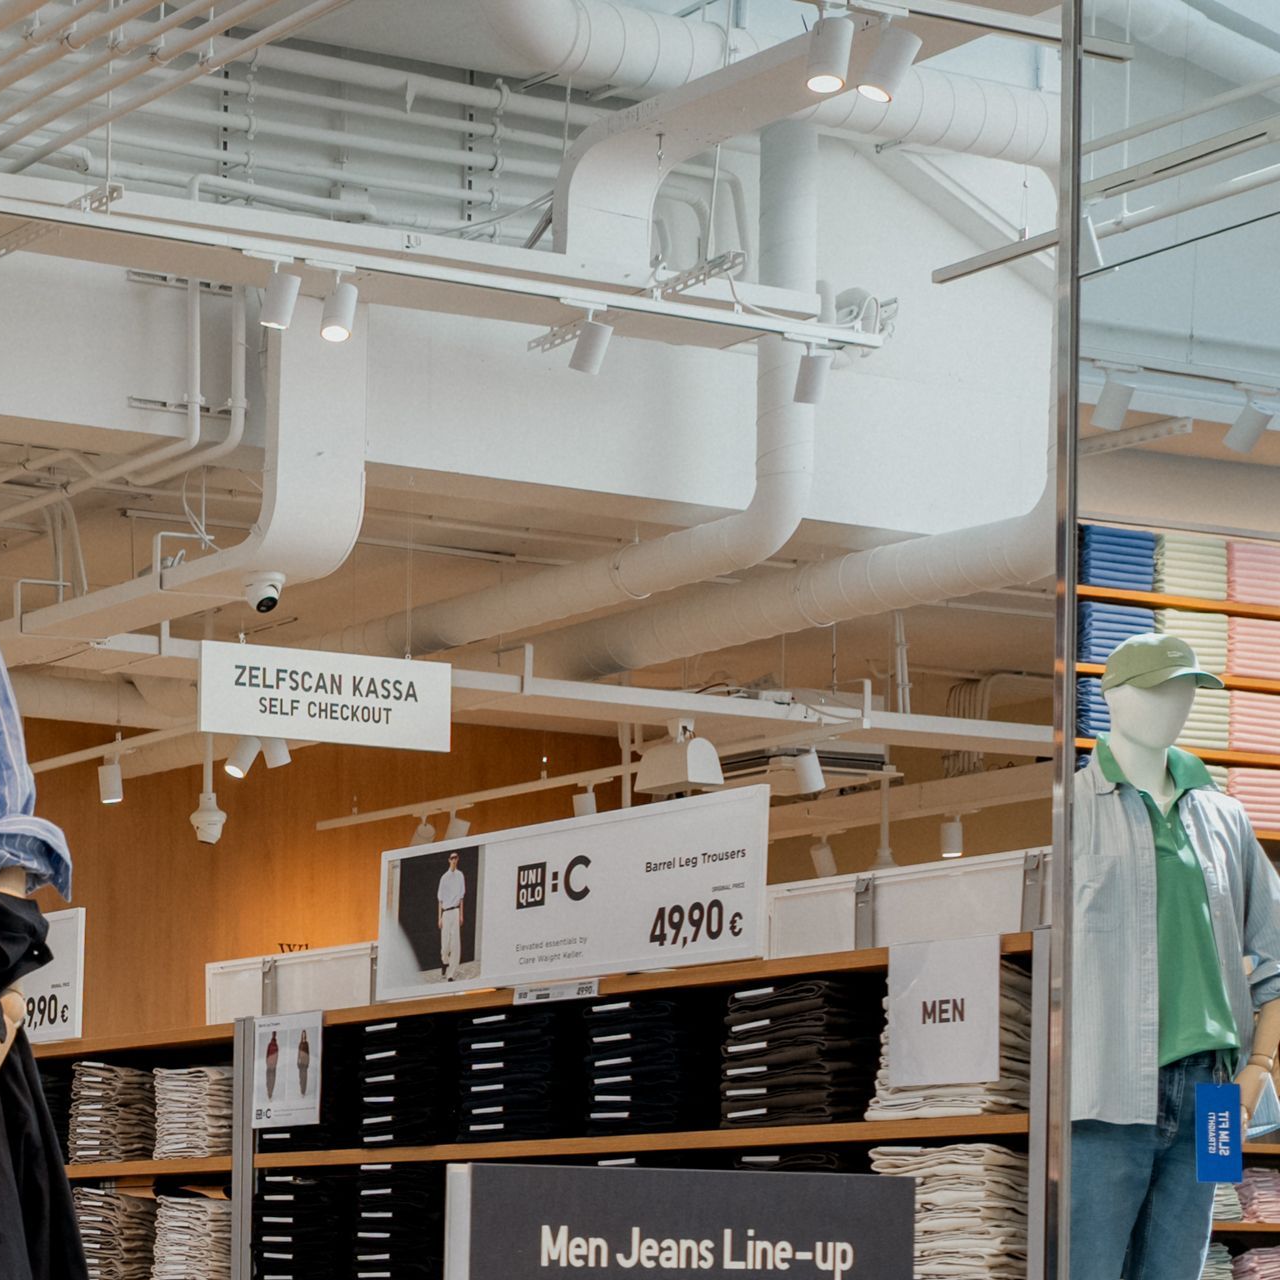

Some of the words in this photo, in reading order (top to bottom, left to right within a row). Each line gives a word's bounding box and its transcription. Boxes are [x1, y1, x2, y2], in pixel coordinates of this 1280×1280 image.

[234, 664, 342, 696] ZELFSCAN
[352, 676, 418, 702] KASSA
[259, 696, 300, 716] SELF
[308, 701, 392, 724] CHECKOUT
[645, 858, 675, 872] Barrel
[679, 856, 698, 868] Leg
[701, 849, 746, 864] Trousers
[519, 867, 542, 886] UNI
[519, 887, 543, 906] QLO
[649, 899, 723, 949] 49,90
[729, 912, 743, 936] €
[921, 998, 965, 1024] MEN
[540, 1224, 609, 1268] Men
[615, 1226, 714, 1270] Jeans
[722, 1228, 854, 1280] Line-up
